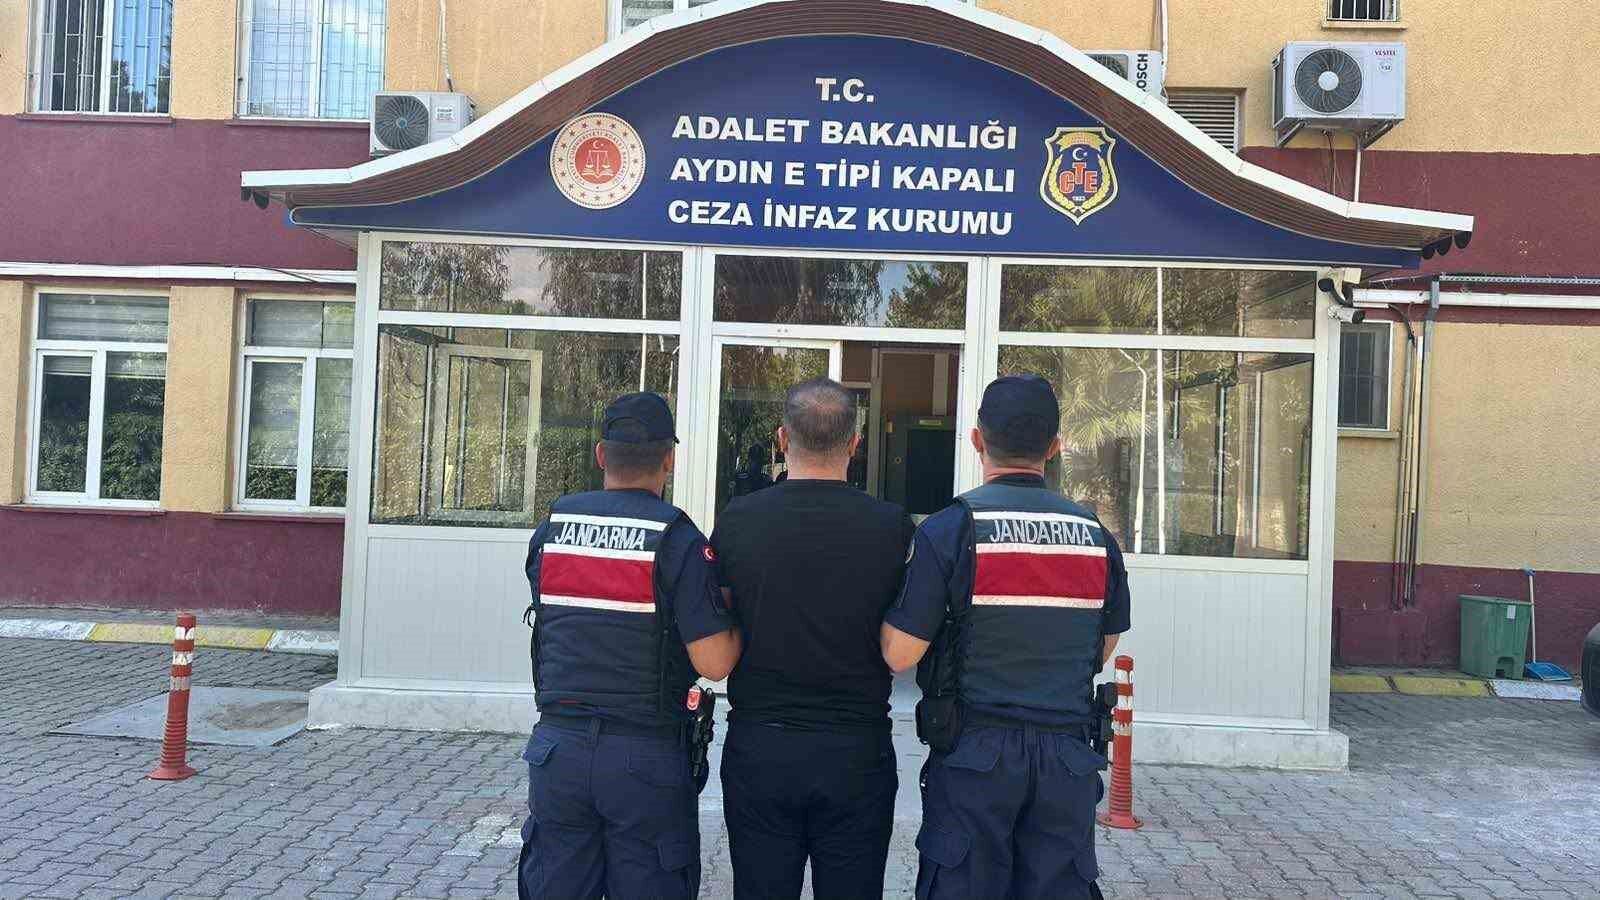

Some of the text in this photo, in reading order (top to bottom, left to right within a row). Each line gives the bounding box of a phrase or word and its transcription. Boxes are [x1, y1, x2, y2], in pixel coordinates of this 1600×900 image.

[1136, 54, 1148, 92] OSCH
[815, 77, 875, 103] T.C.
[671, 115, 1017, 150] ADALET BAKANLIĞI
[669, 157, 1015, 193] AYDIN E TİPİ KAPALI
[1060, 162, 1098, 193] CTE
[668, 198, 1013, 236] CEZA İNFAZ KURUMU
[555, 522, 646, 550] JANDARMA
[990, 519, 1095, 545] JANDARMA
